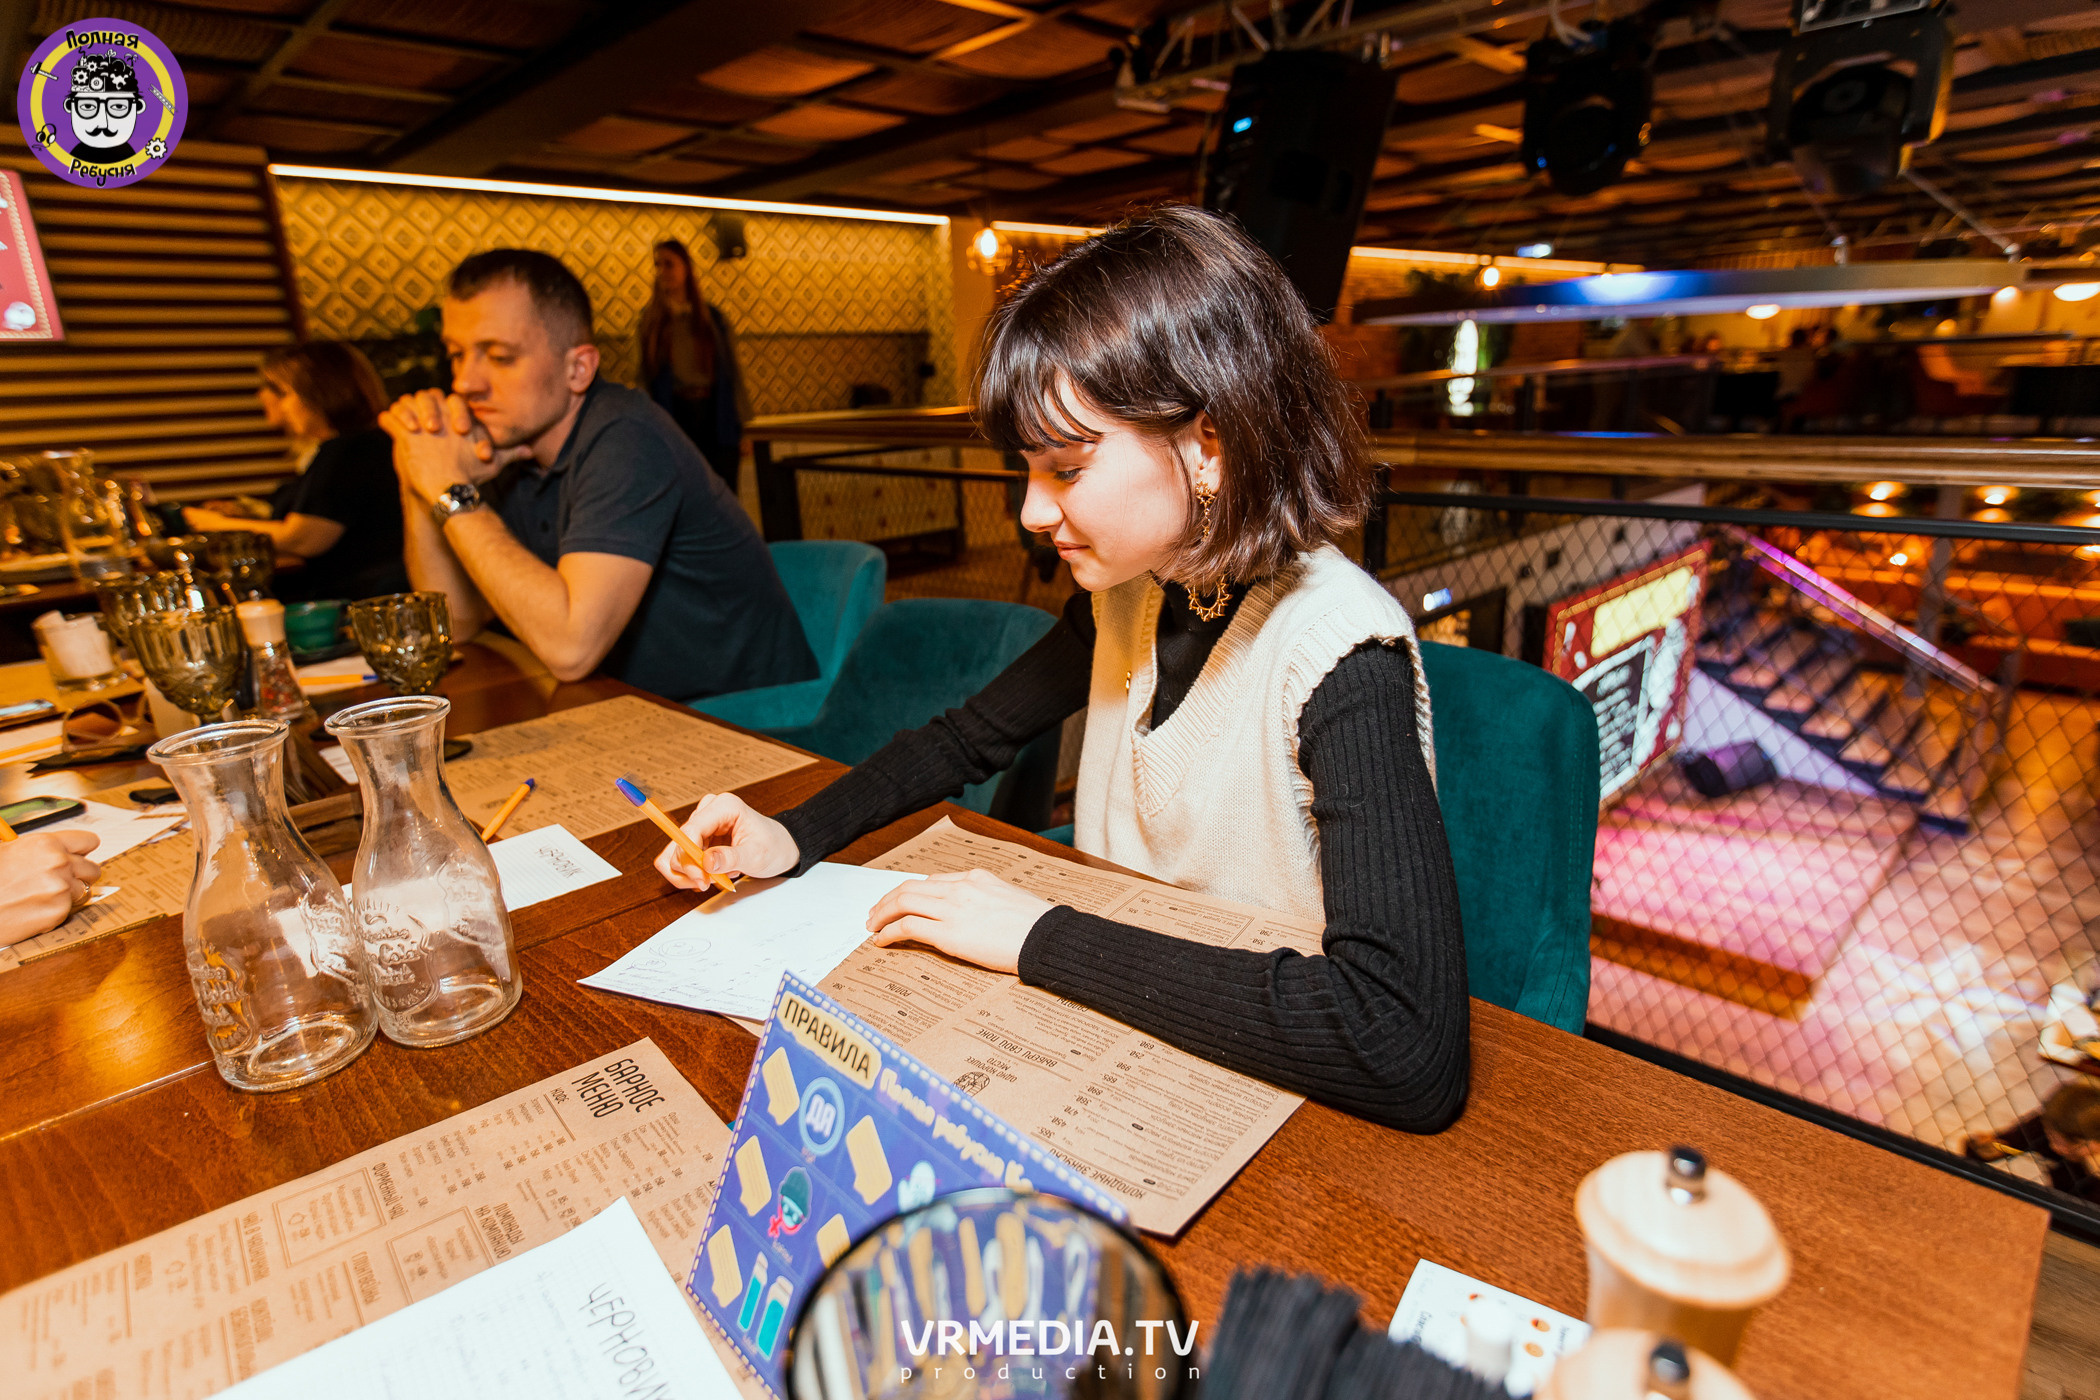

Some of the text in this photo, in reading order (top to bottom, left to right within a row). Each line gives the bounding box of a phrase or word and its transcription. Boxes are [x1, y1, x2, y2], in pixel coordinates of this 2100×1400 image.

[784, 997, 872, 1081] ПРАВИЛА
[974, 1027, 1057, 1067] ВЫБЕРИ СВОЙ ПОКЕ
[1124, 1047, 1145, 1059] 250.-
[1135, 1038, 1155, 1050] 690.-
[963, 1055, 1017, 1083] ОДНО ХОРОШЕЕ
[985, 1056, 1011, 1071] МЕСТО
[1111, 1059, 1132, 1071] 990.-
[550, 1087, 570, 1104] КОФЕ
[571, 1071, 624, 1119] МЕНЮ
[604, 1058, 665, 1113] БАРНОЕ
[1071, 1093, 1092, 1105] 360.-
[1083, 1083, 1103, 1095] 890.-
[805, 1093, 837, 1138] ДА
[1045, 1114, 1068, 1127] 450.-
[1059, 1104, 1080, 1116] 470.-
[1033, 1125, 1056, 1138] 365.-
[1045, 1147, 1092, 1175] ЗАКУСКИ
[371, 1160, 410, 1220] ФИРМЕННЫЙ ЧАЙ
[1088, 1169, 1147, 1199] ХОЛОДНЫЕ
[474, 1204, 512, 1258] НА КОМПАНИЮ
[493, 1202, 527, 1244] ЛИМОНАДЫ
